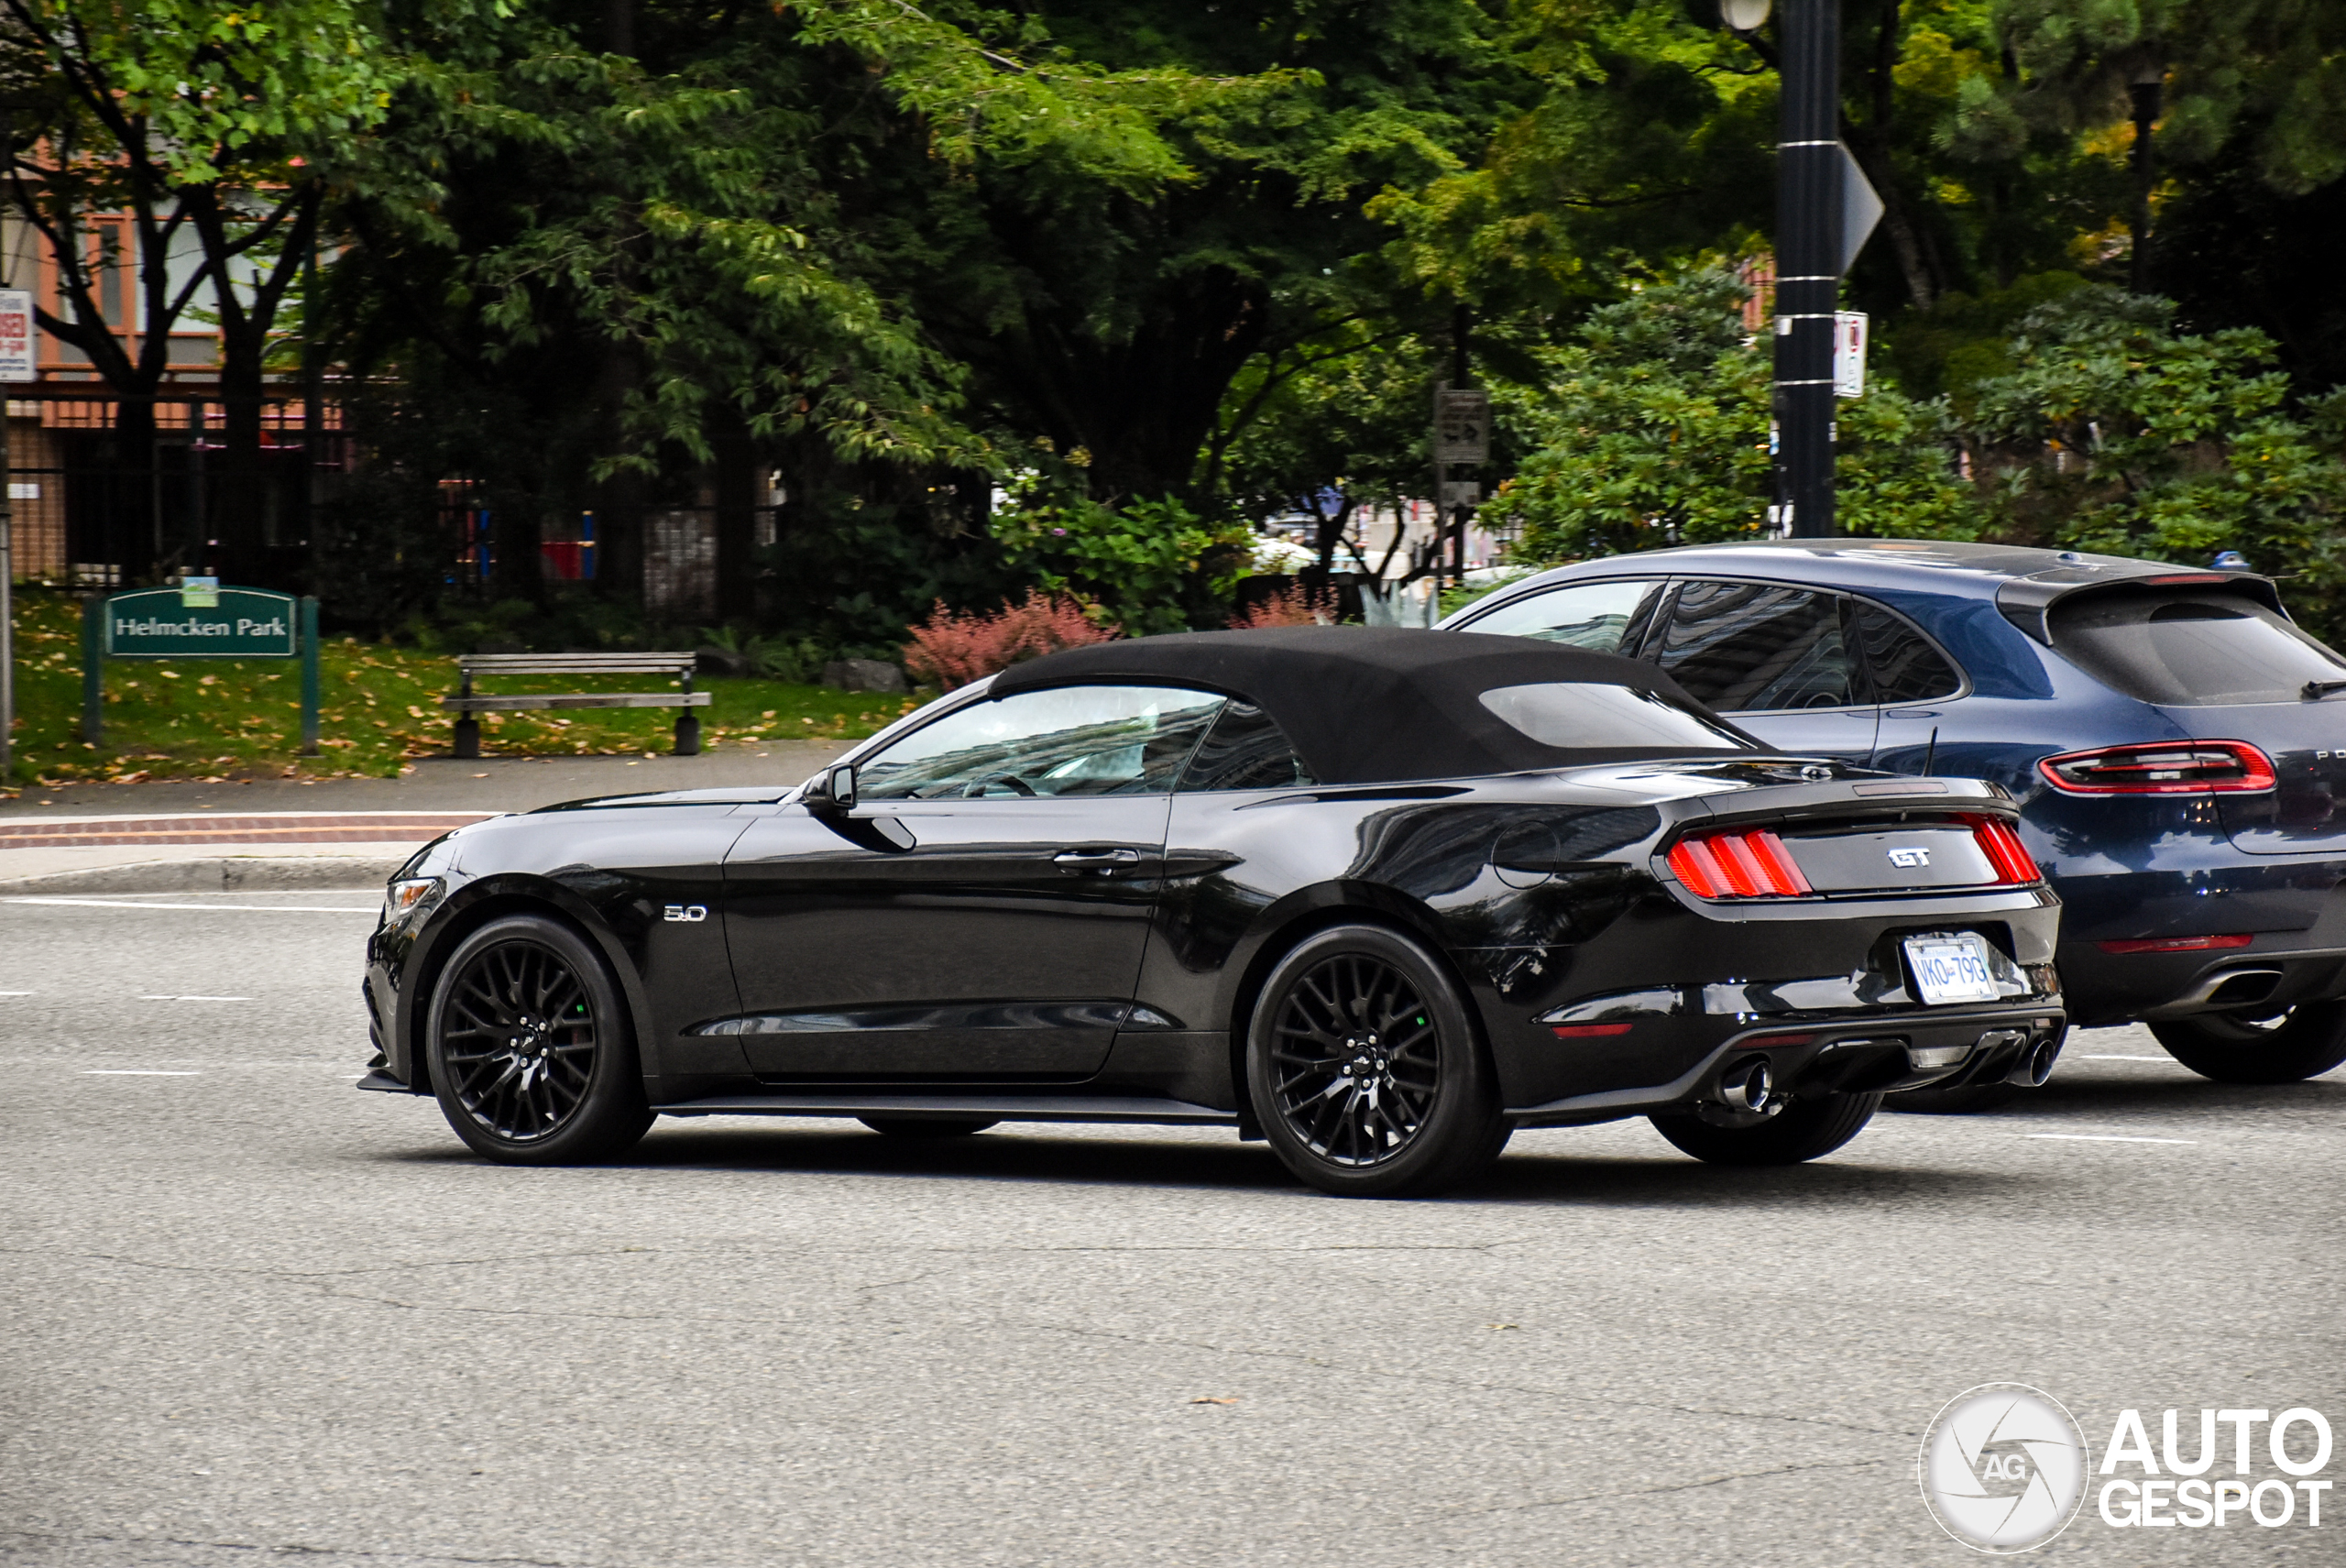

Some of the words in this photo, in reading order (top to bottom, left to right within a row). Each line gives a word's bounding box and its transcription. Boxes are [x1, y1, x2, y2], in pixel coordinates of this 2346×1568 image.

[115, 617, 230, 636] Helmcken
[236, 617, 286, 636] Park
[1888, 848, 1930, 868] GT
[663, 905, 707, 922] 5.0
